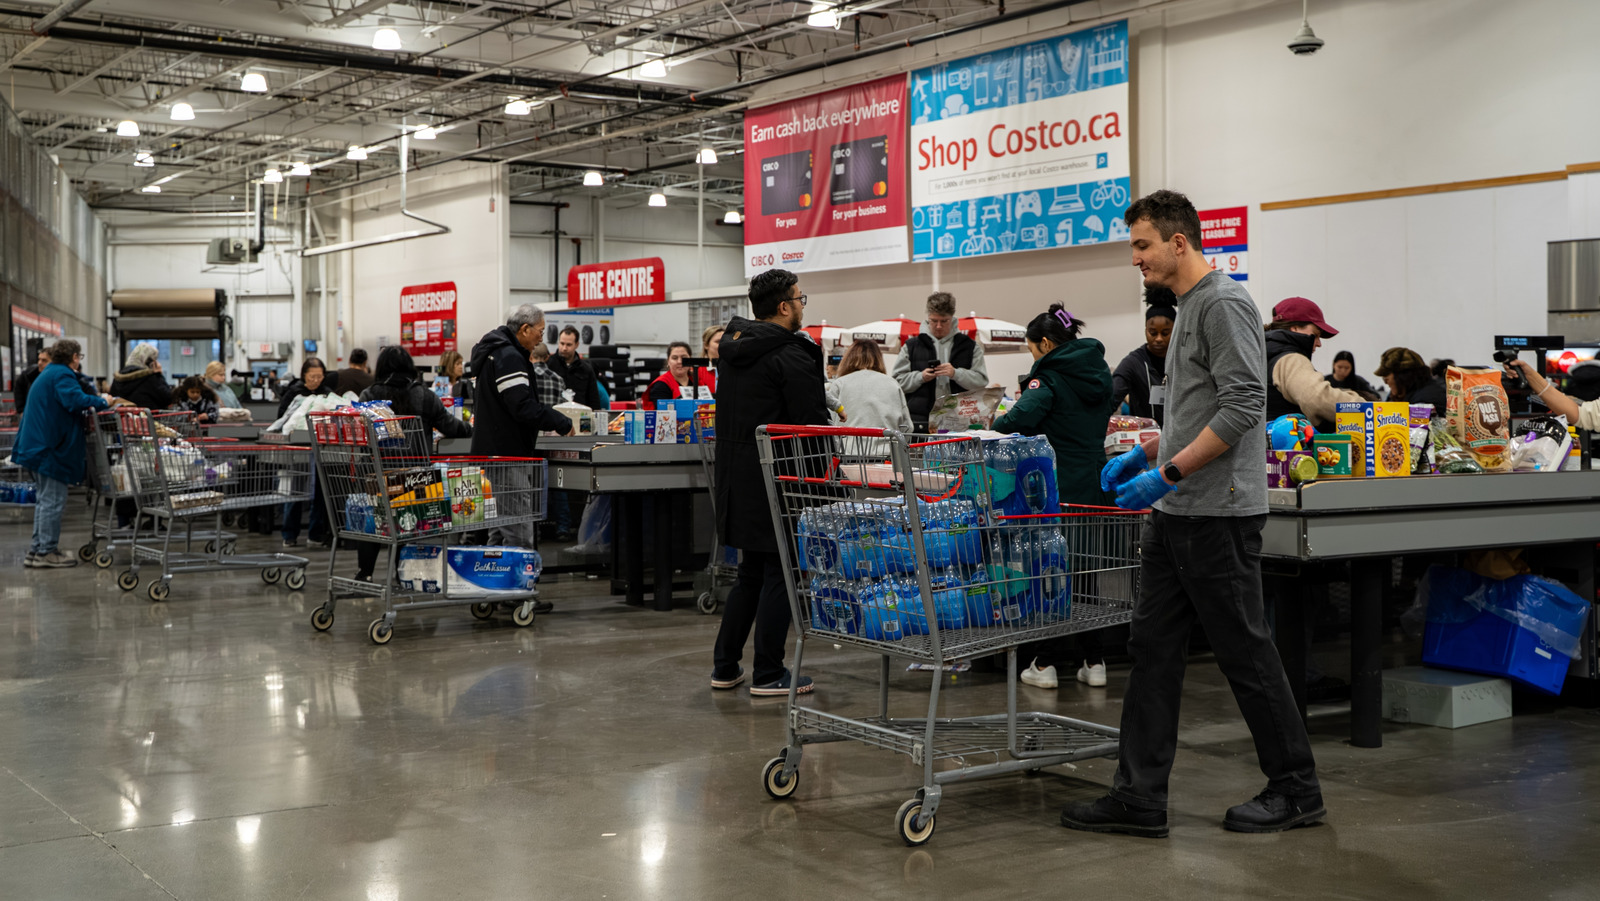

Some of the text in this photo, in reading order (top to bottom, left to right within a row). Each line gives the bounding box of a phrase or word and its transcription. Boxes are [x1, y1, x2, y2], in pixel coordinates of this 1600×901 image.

[751, 98, 900, 144] Earn cash back everywhere
[918, 111, 1121, 171] Shop Costco.ca
[1029, 167, 1041, 175] local
[1042, 165, 1060, 174] Costco
[832, 204, 887, 221] For your business
[775, 217, 797, 229] For you
[1200, 217, 1241, 230] BER'S PRICE
[1205, 227, 1236, 239] GASOLINE
[751, 254, 767, 267] CIBC
[577, 265, 655, 300] TIRE CENTRE
[401, 289, 456, 314] MEMBERSHIP
[854, 333, 885, 341] KIRKLAND
[992, 330, 1026, 339] KIRKLAND
[1478, 401, 1498, 414] QUE
[1376, 412, 1408, 428] Shreddies
[1482, 412, 1500, 424] PASA
[1337, 423, 1364, 434] Shreddies
[1365, 407, 1375, 464] JUMBO
[461, 479, 476, 490] All-
[453, 487, 478, 497] Bran
[473, 561, 512, 572] Bath Tissue
